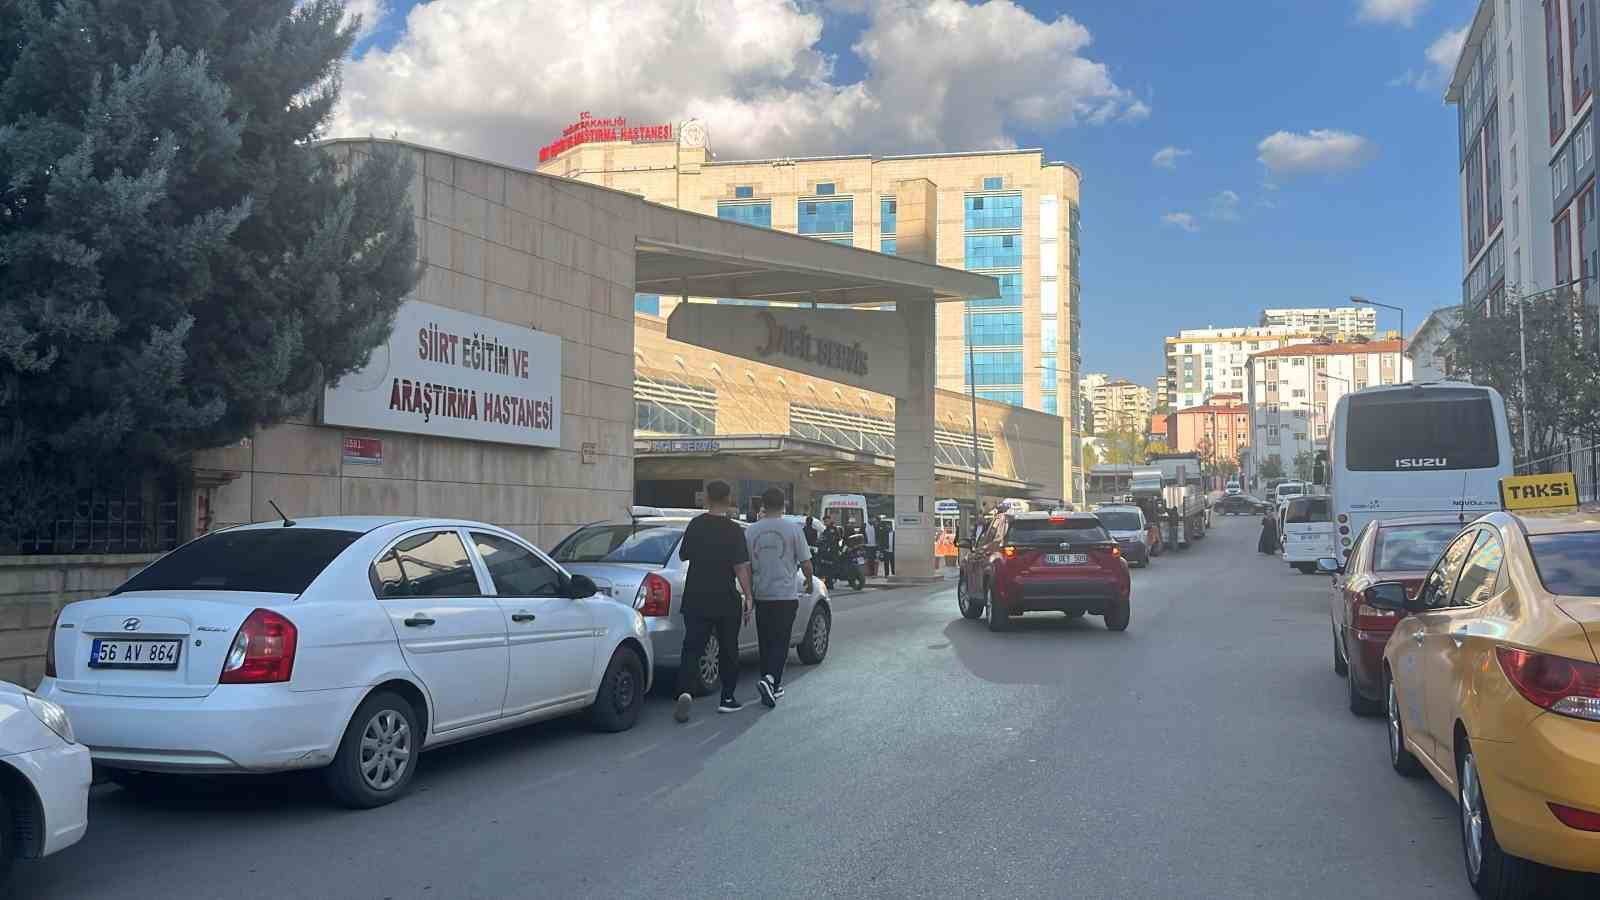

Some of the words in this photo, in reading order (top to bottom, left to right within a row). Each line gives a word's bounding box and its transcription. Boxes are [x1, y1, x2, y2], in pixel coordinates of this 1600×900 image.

[418, 322, 459, 366] SİİRT
[462, 331, 509, 376] EĞİTİM
[511, 349, 529, 379] VE
[388, 377, 478, 423] ARAŞTIRMA
[483, 391, 553, 431] HASTANESİ
[1395, 457, 1447, 468] ISUZU
[99, 645, 117, 661] 56
[125, 645, 142, 661] AV
[149, 644, 174, 661] 864
